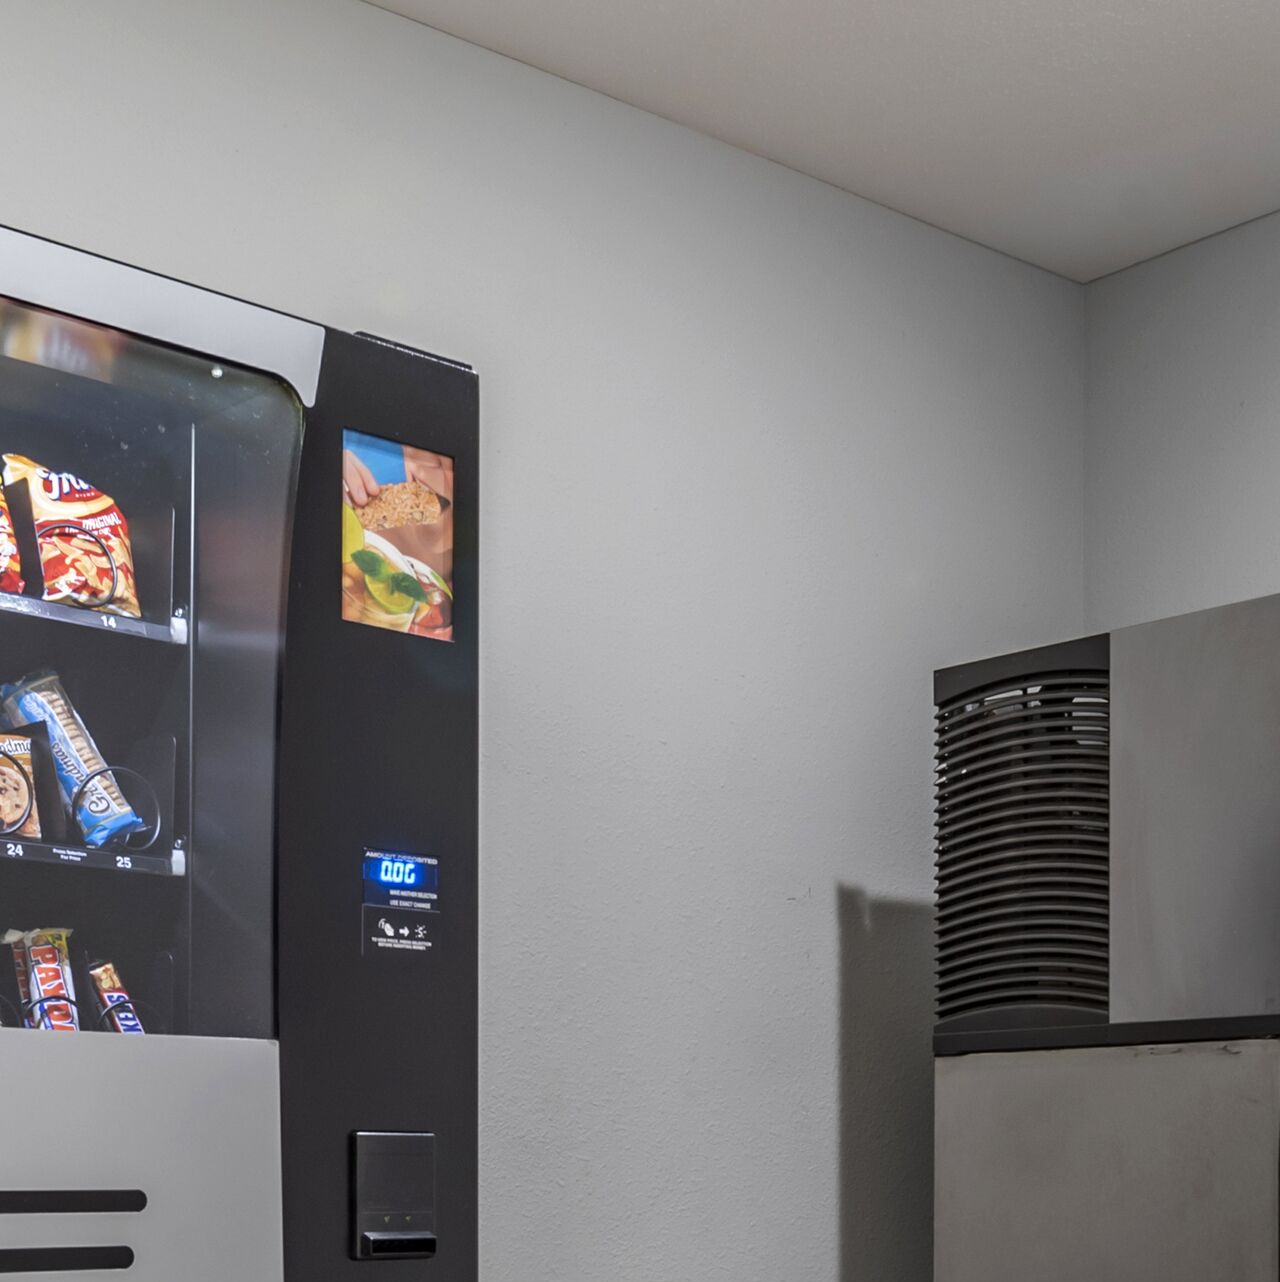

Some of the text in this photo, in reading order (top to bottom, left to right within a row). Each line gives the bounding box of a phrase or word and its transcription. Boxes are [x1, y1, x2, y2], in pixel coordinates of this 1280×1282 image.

[101, 615, 117, 628] 14
[6, 843, 24, 857] 24
[116, 855, 132, 869] 25
